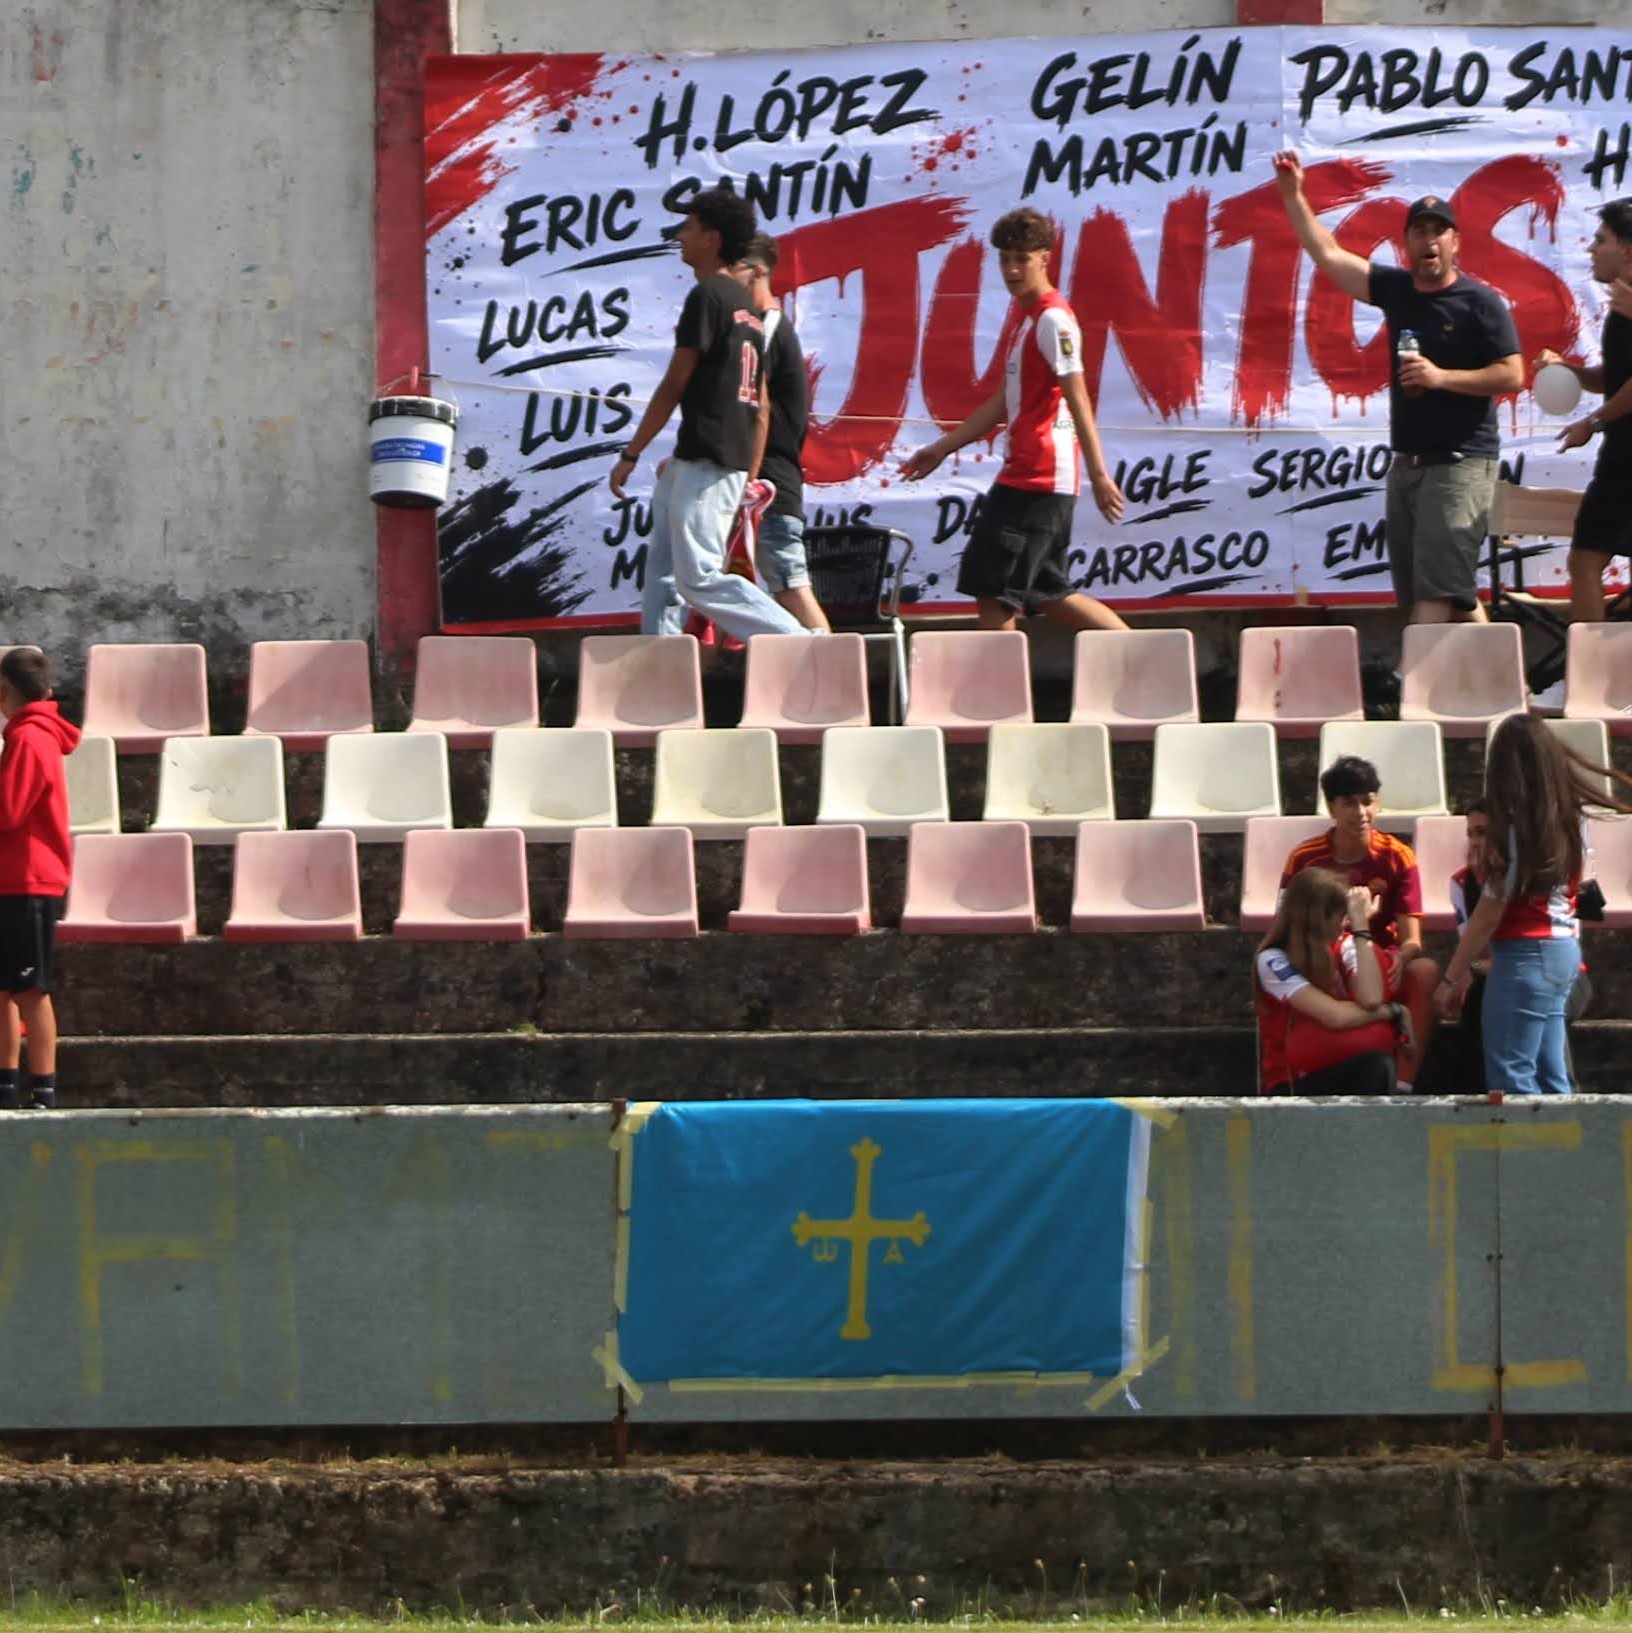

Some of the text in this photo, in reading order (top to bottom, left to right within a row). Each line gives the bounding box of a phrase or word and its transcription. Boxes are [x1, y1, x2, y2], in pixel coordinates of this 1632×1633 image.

[634, 68, 944, 169] H.LÓPEZ
[1031, 32, 1242, 128] GELÍN
[1288, 43, 1490, 126] PABLO
[1021, 113, 1247, 199] MARTÍN
[500, 188, 643, 267] ERIC
[476, 286, 631, 363] LUCAS
[765, 152, 1583, 488] JUNTOS
[519, 381, 634, 455] LUIS
[1248, 442, 1392, 499] SERGIO
[1068, 529, 1270, 590] CARRASCO
